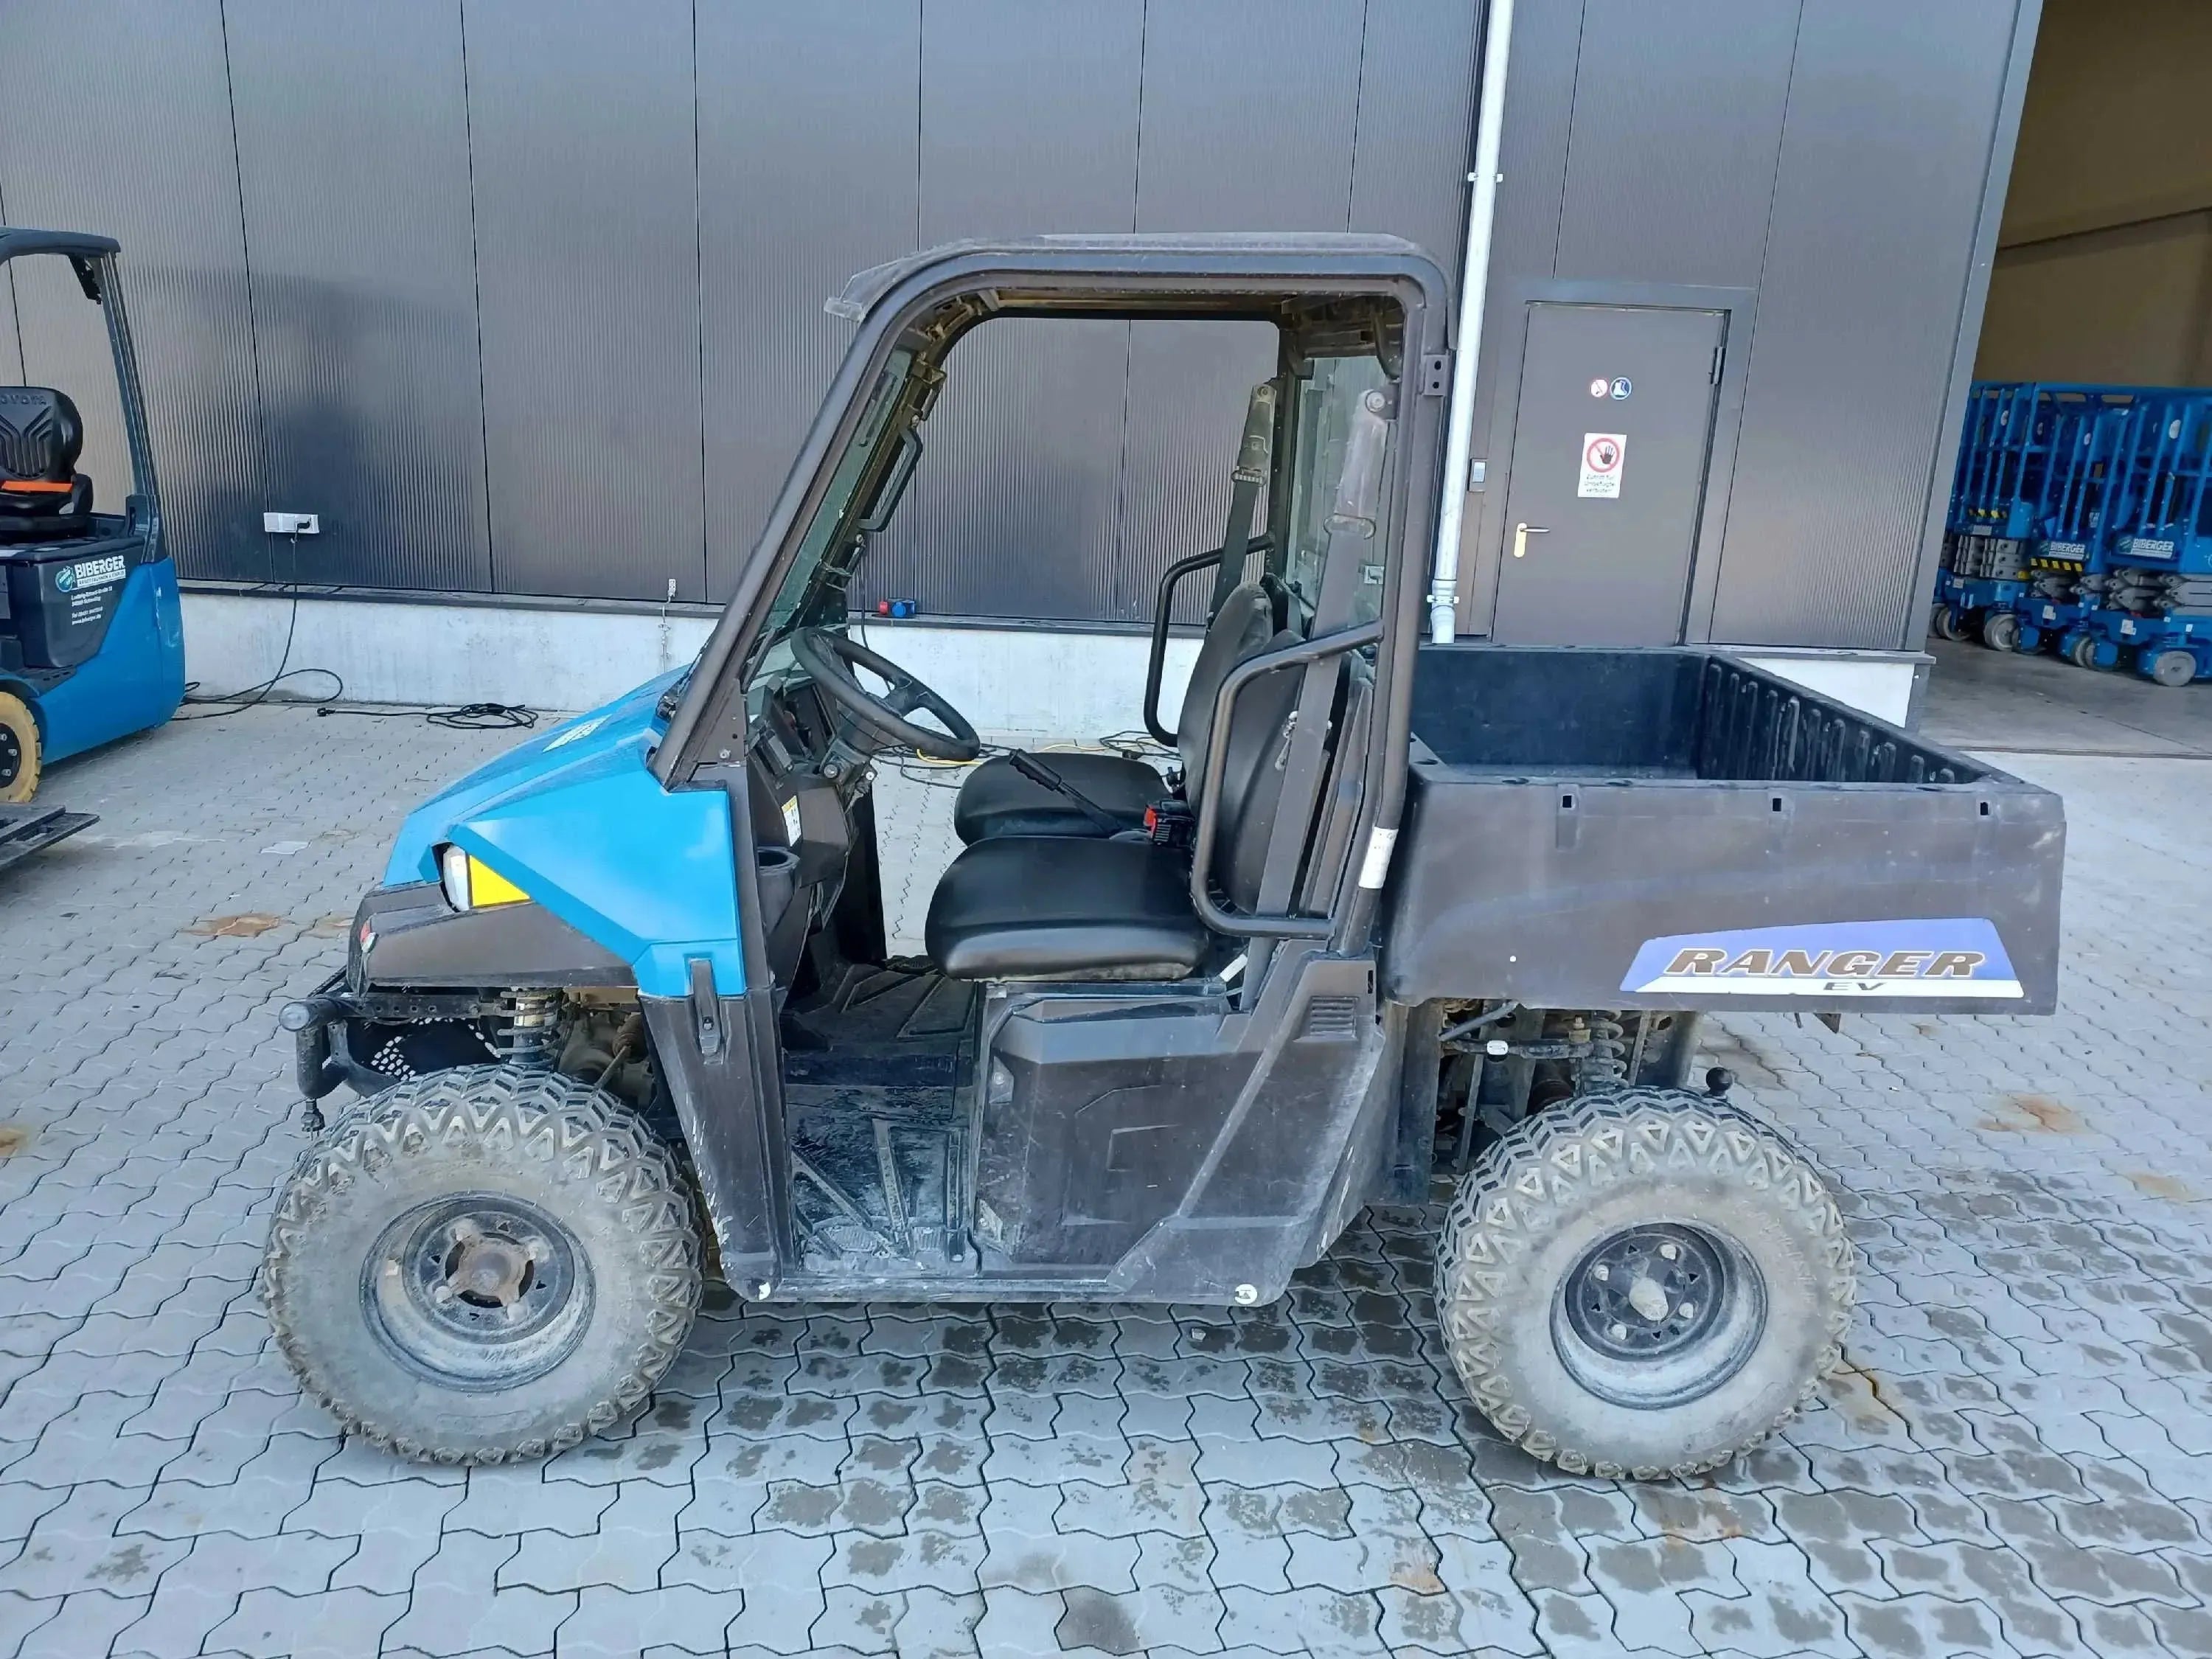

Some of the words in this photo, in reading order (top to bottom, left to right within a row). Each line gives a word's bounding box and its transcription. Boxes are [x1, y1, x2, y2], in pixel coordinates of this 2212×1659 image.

[2050, 542, 2086, 553] BIBERGER
[2132, 538, 2174, 551] BIBERGER
[74, 555, 125, 579] BIBERGER
[1663, 948, 1985, 977] RANGER
[1823, 981, 1886, 991] EV
